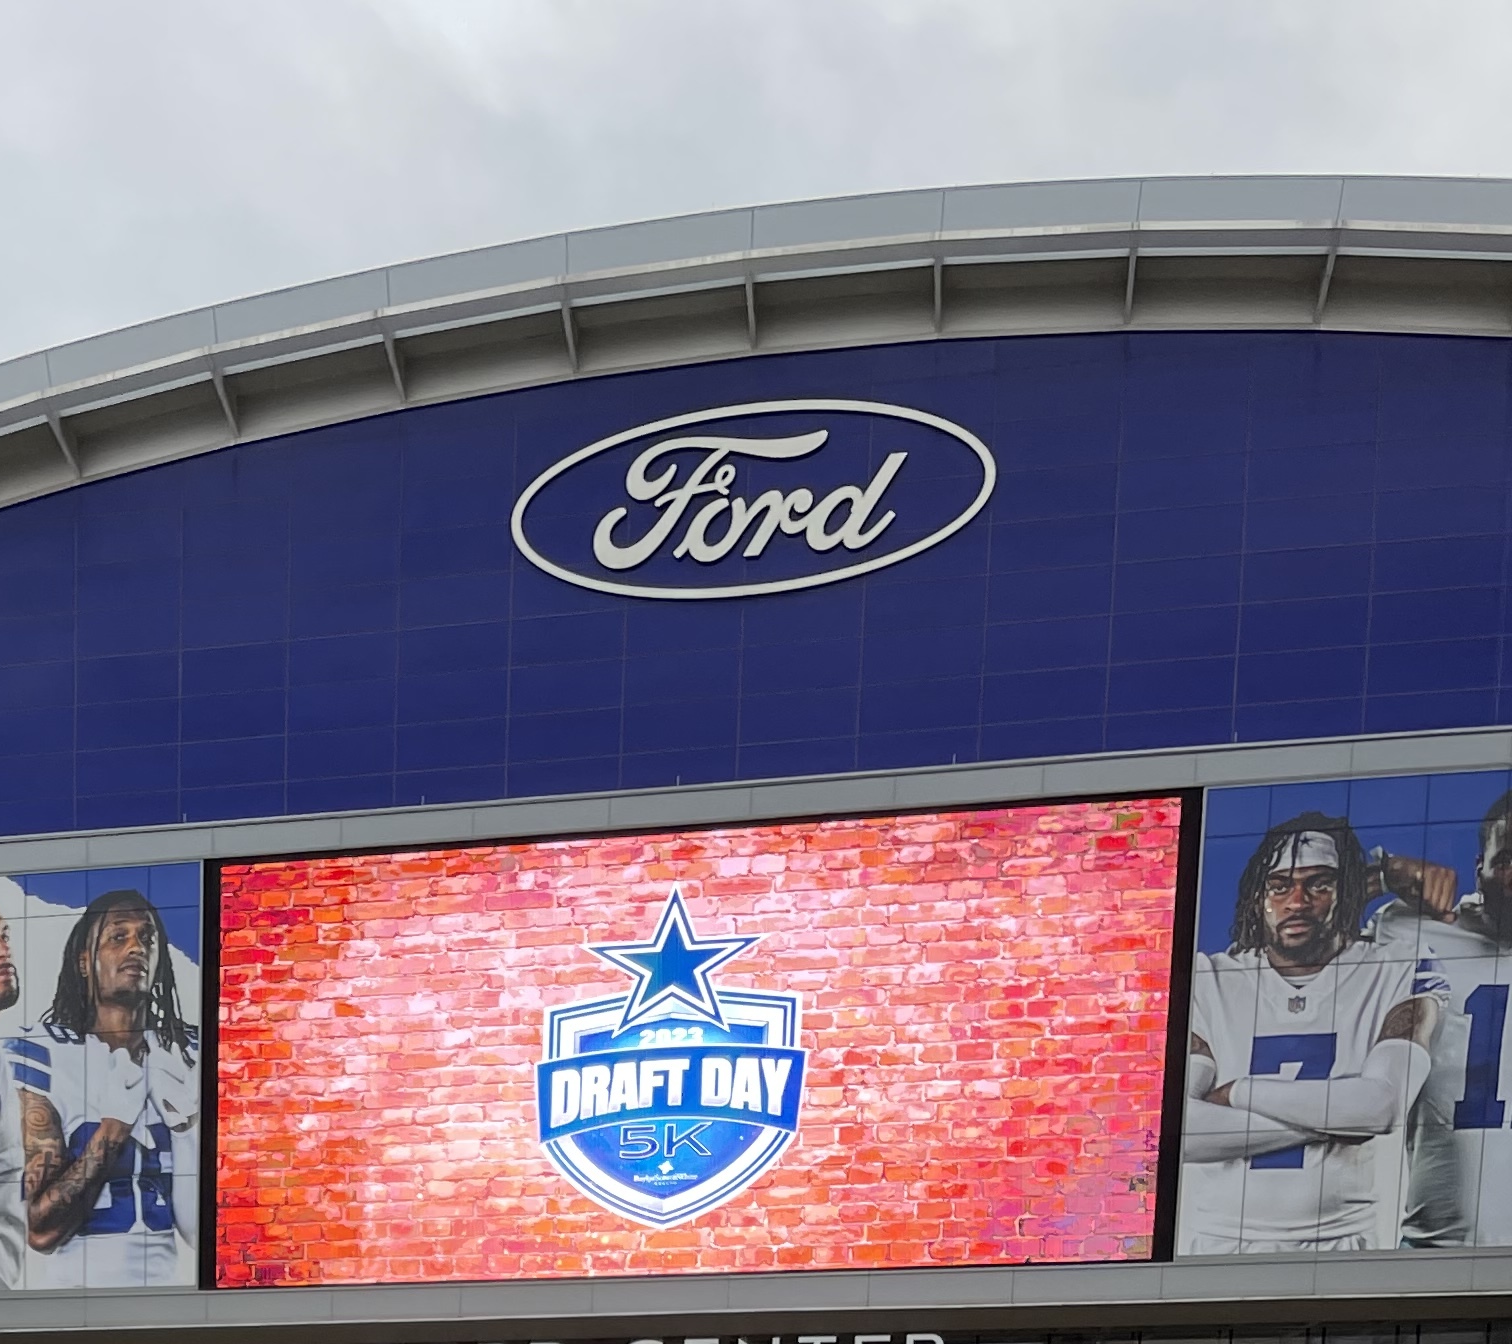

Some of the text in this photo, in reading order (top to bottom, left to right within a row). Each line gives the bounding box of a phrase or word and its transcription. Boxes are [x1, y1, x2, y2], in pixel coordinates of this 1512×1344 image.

[593, 429, 908, 570] Ford
[549, 1057, 794, 1129] DRAFT DAY
[618, 1121, 714, 1161] 5K
